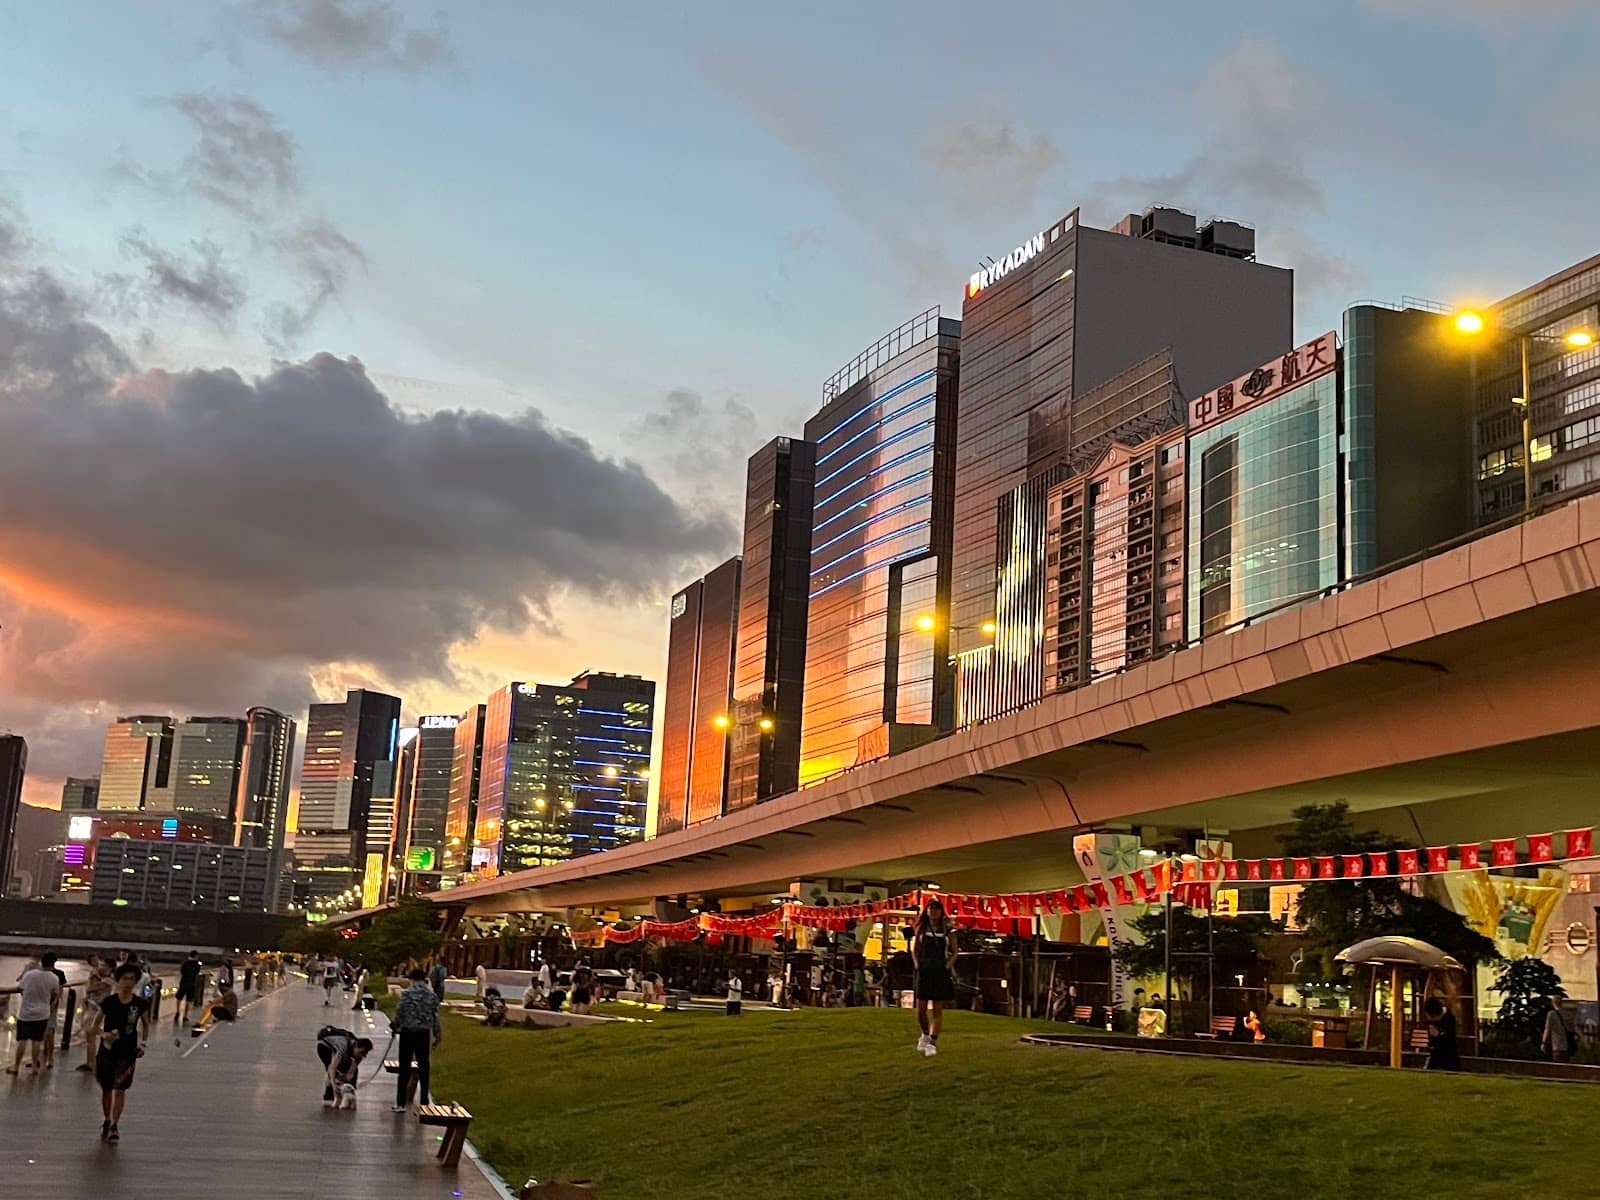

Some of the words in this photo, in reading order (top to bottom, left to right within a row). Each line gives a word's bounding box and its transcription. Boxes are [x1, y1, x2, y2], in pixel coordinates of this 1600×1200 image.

[979, 231, 1045, 290] RYKADAN
[1195, 383, 1234, 424] 中國
[1281, 337, 1327, 387] 航天
